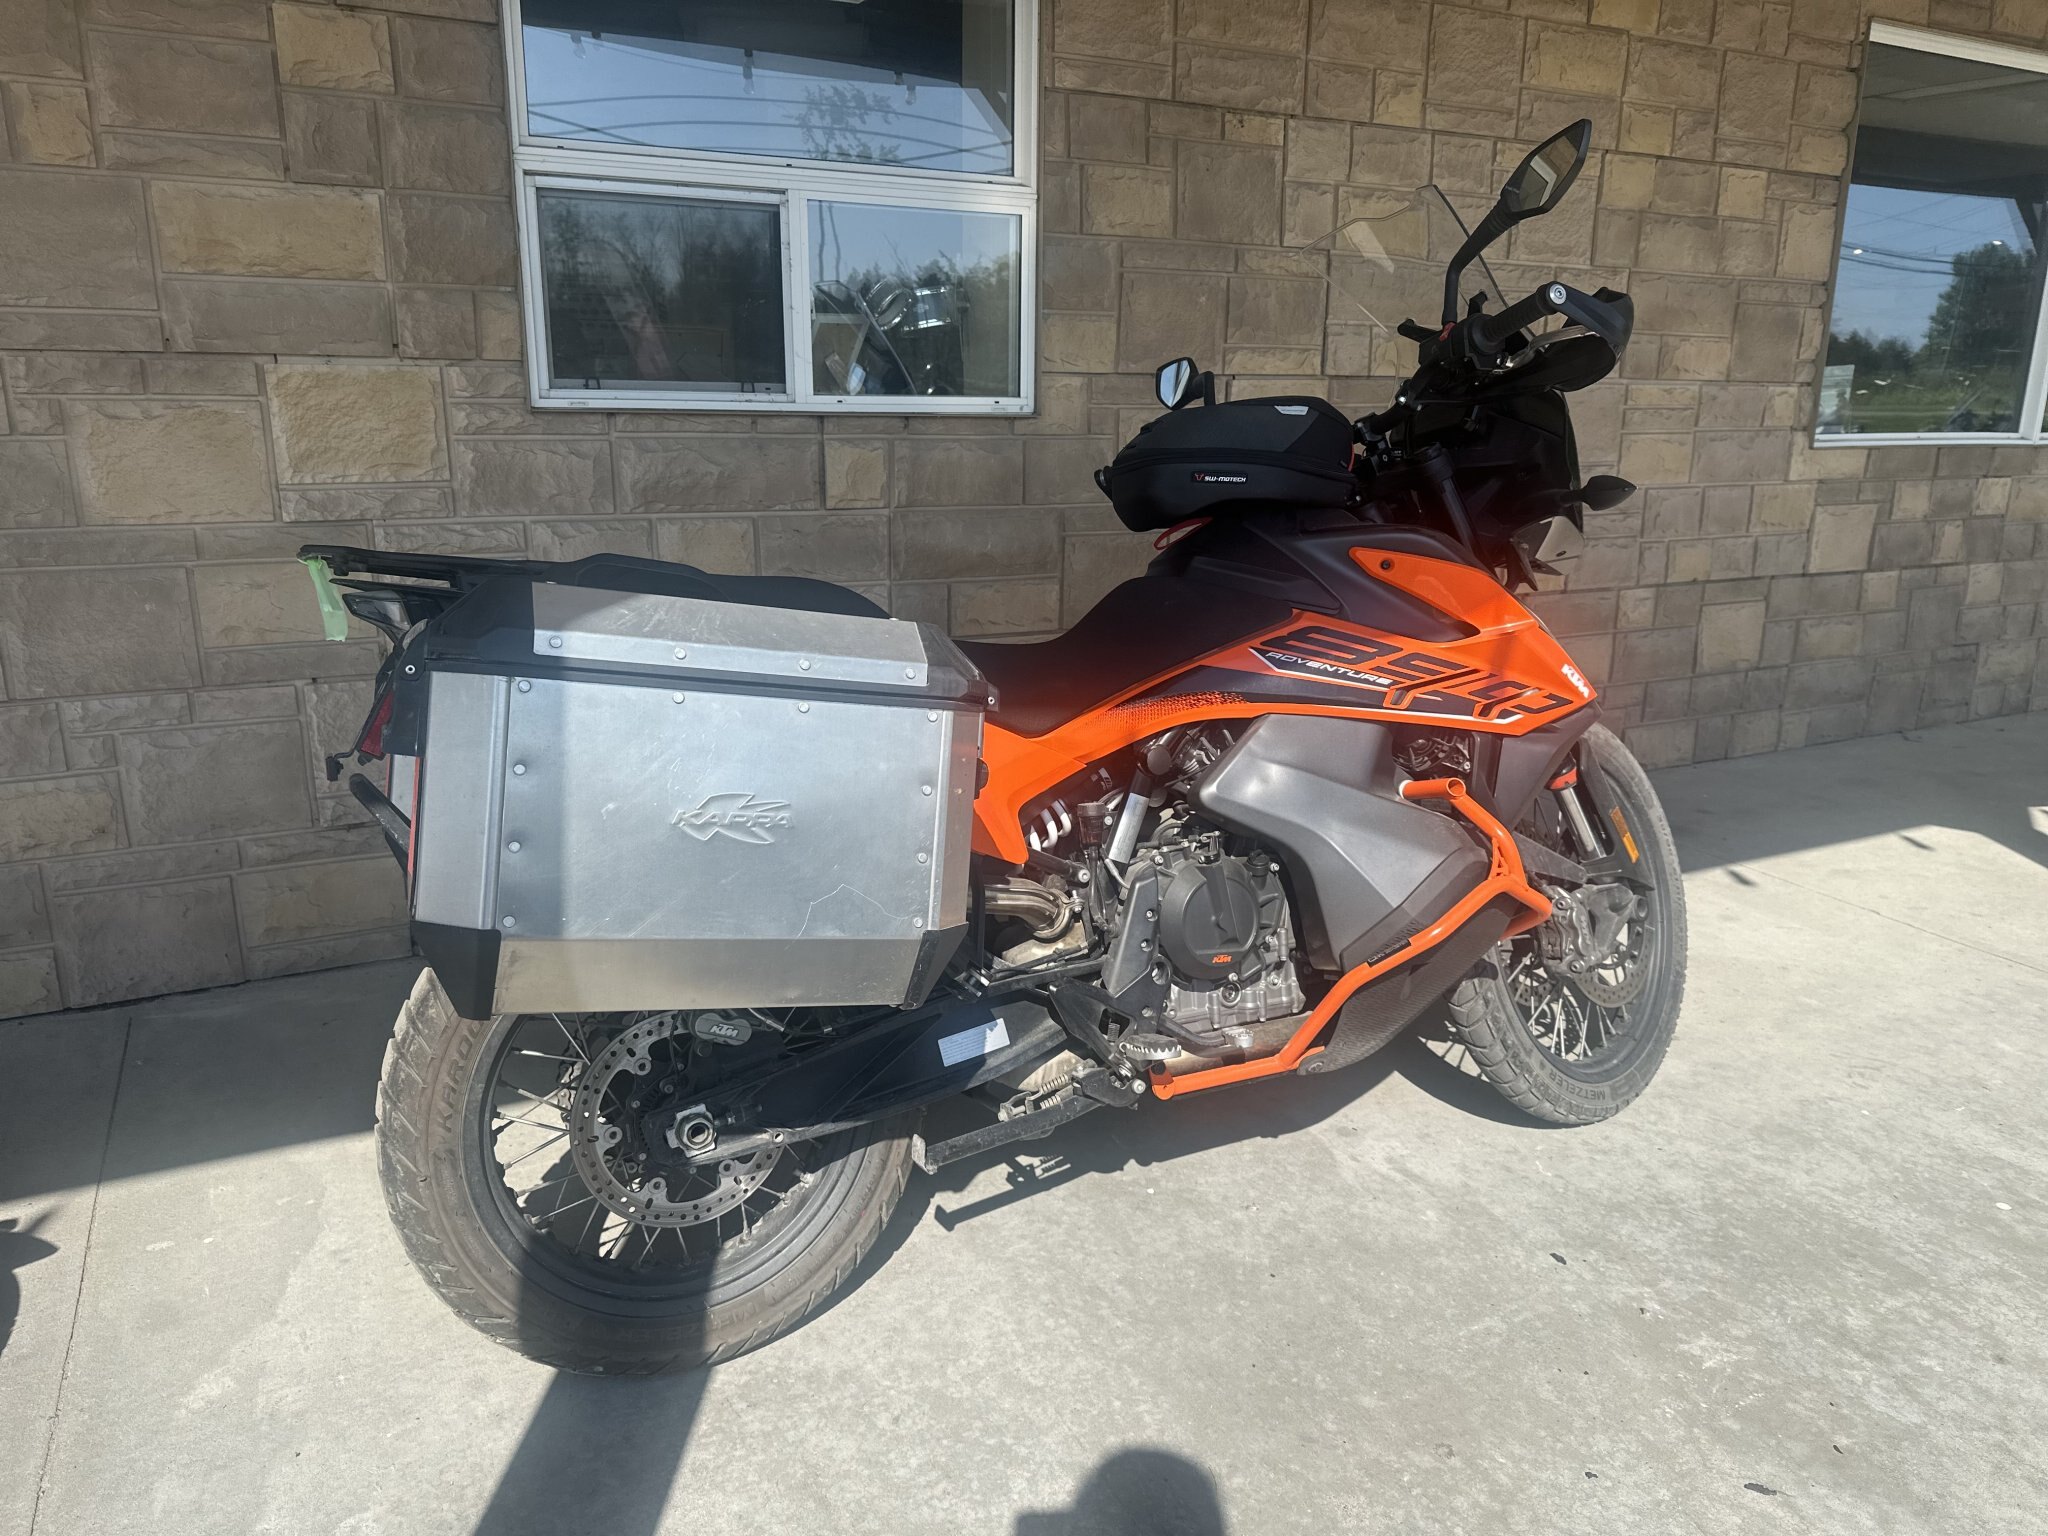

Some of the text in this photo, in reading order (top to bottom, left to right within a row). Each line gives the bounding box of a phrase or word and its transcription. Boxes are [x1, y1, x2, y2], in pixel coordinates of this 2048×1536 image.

[1204, 475, 1247, 483] SW-MOTECH
[1265, 650, 1394, 686] ADVENTURE
[1560, 663, 1590, 699] KTM
[1212, 954, 1232, 964] KTM
[710, 1023, 739, 1038] KTM
[1549, 1068, 1606, 1101] METZELER
